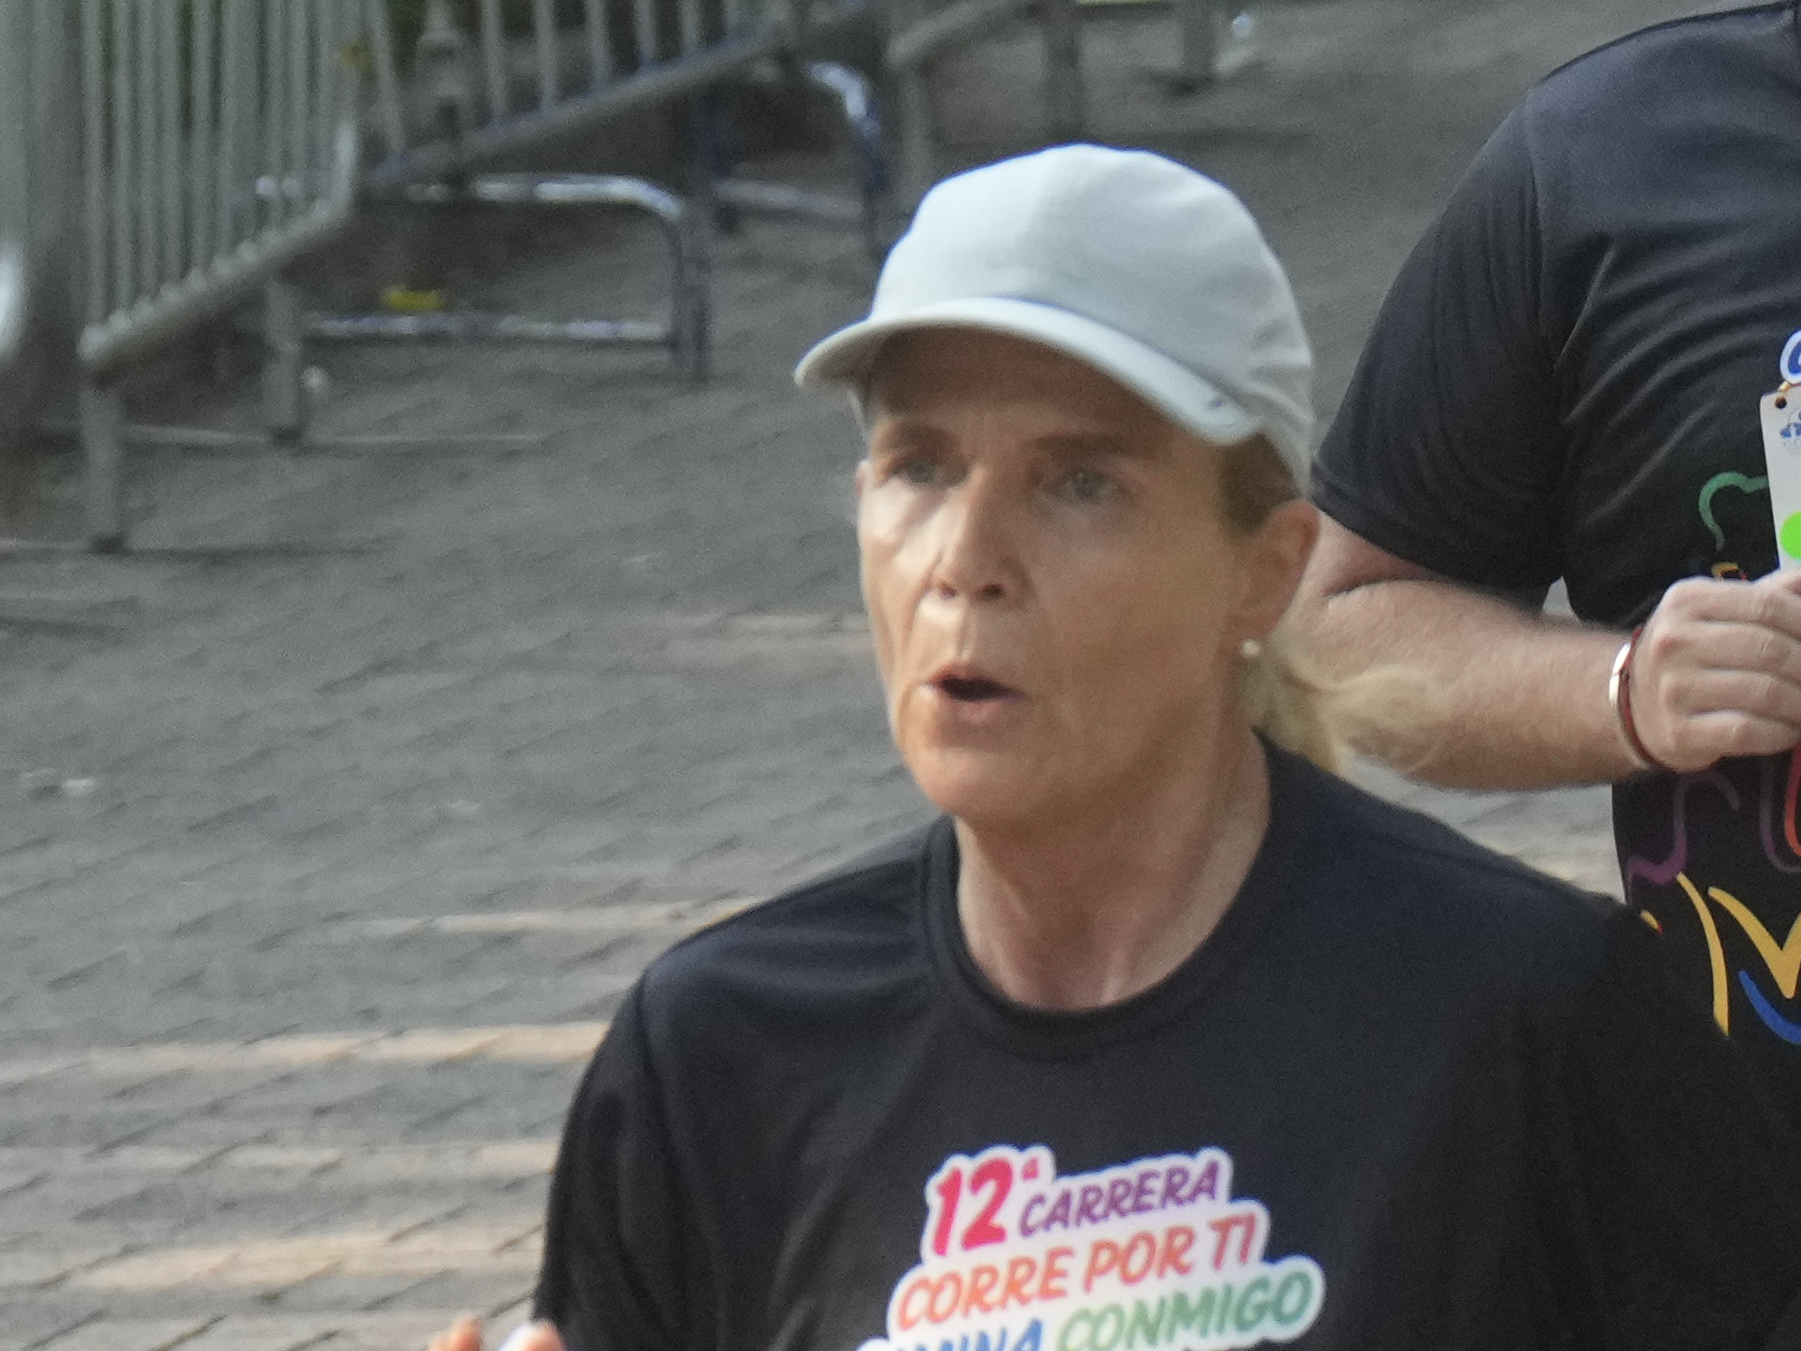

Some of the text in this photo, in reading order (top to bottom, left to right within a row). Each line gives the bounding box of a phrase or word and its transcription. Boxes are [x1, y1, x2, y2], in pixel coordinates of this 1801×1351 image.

[1019, 1159, 1220, 1238] CARRERA
[897, 1212, 1257, 1331] CORRE POR TI
